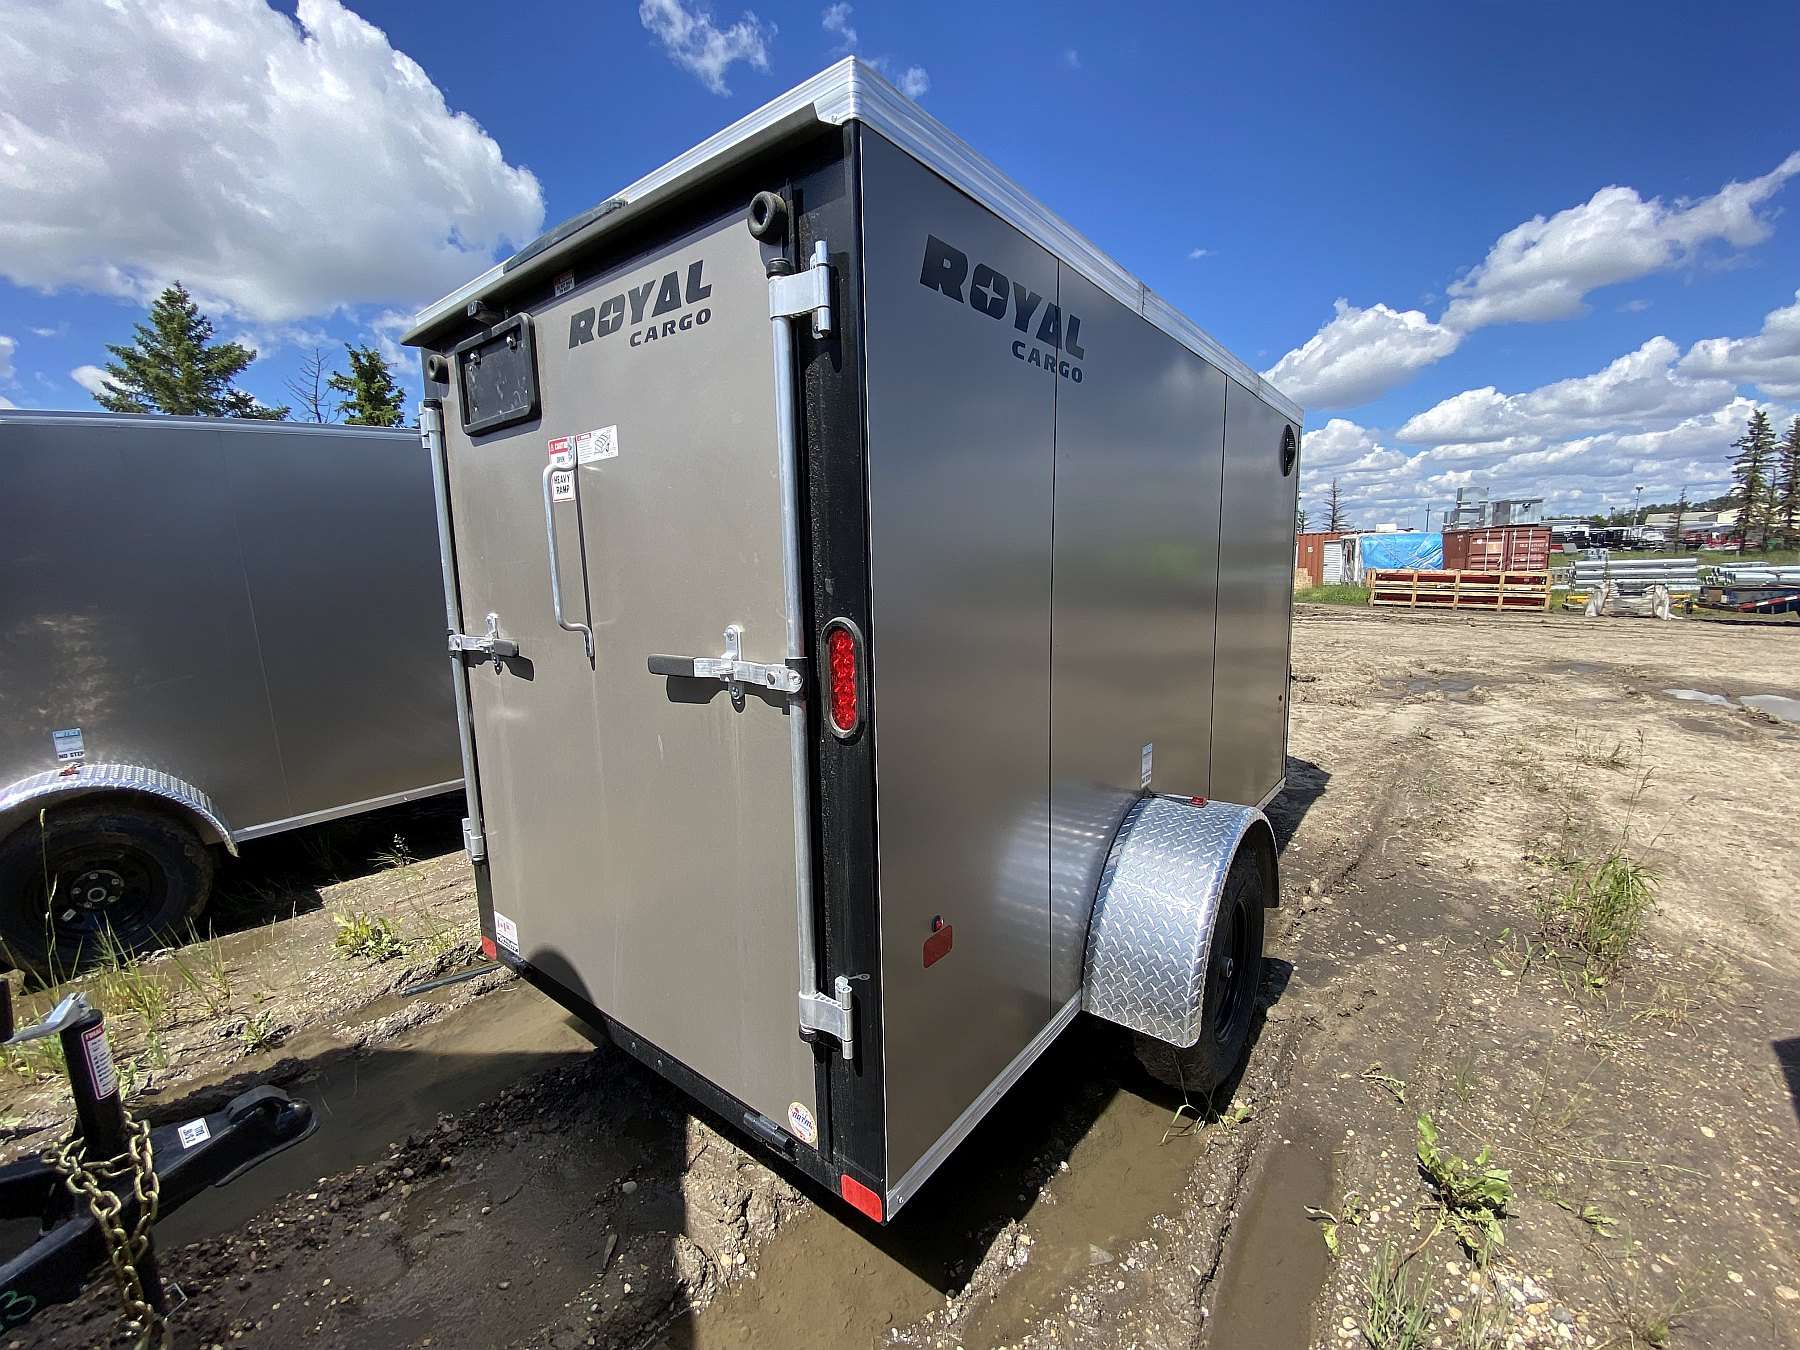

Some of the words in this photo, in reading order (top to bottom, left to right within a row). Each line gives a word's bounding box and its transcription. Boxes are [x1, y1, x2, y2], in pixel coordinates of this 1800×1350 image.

[569, 259, 713, 349] ROYAL
[920, 234, 1085, 360] ROYAL
[629, 308, 712, 347] CARGO
[1012, 340, 1083, 384] CARGO
[553, 473, 571, 485] HEAVY
[556, 485, 570, 495] RAMP
